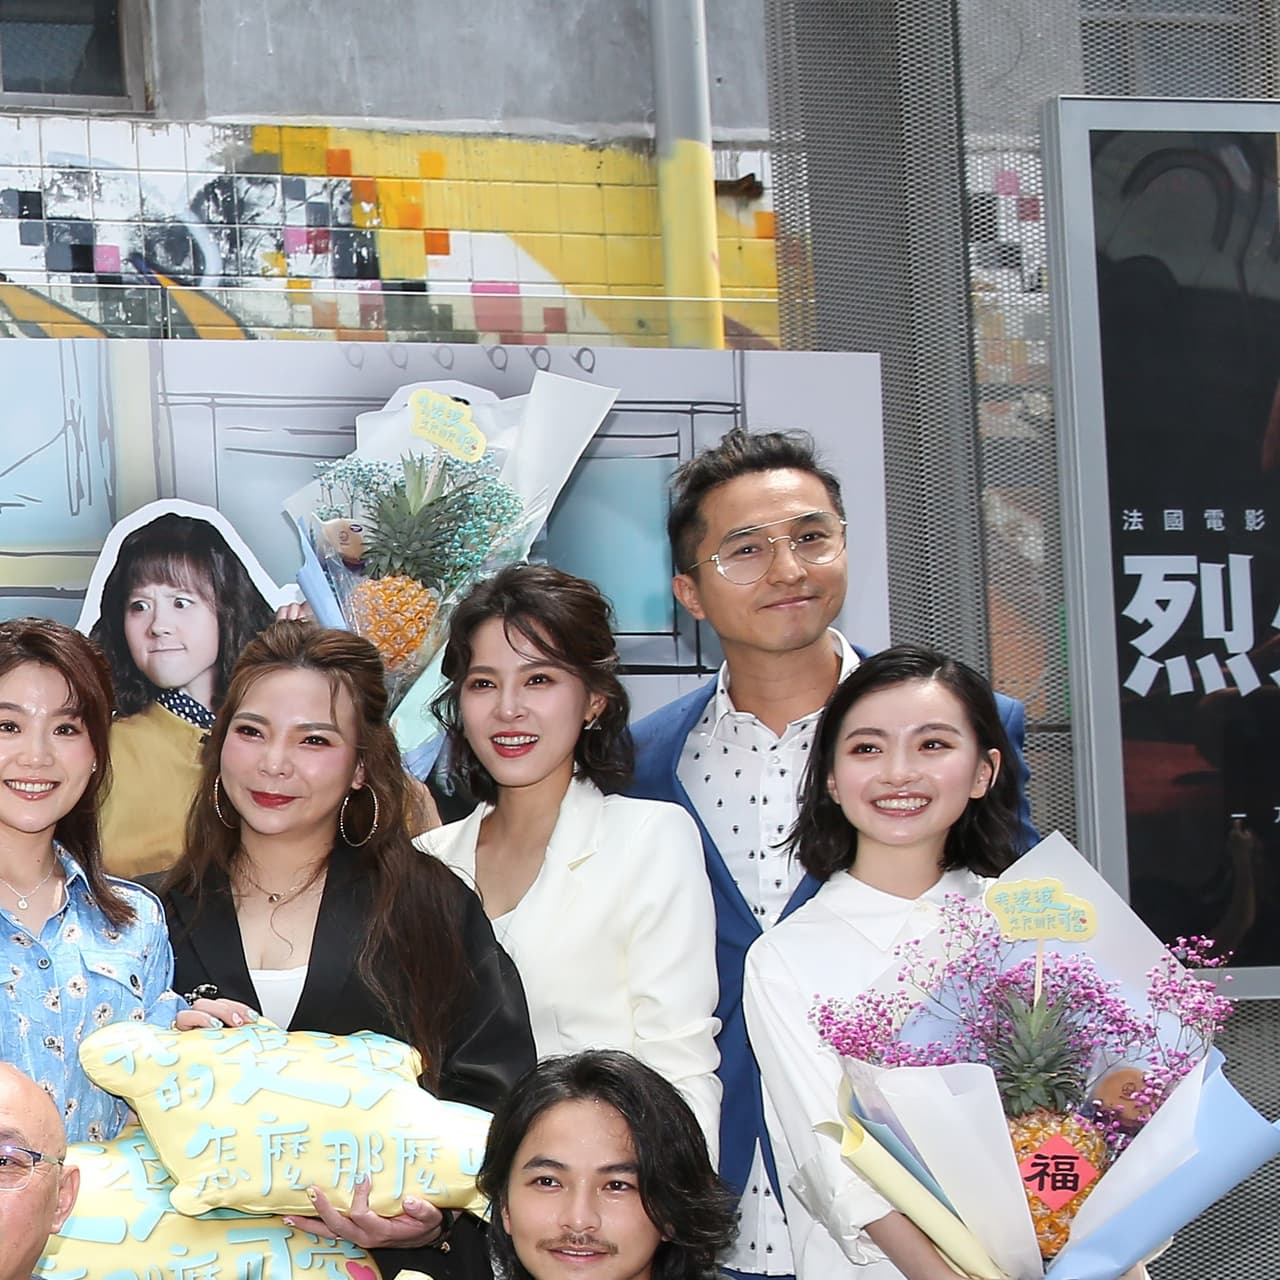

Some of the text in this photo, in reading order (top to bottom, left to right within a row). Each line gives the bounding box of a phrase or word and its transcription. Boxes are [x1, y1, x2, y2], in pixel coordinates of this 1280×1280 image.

[1122, 508, 1266, 532] 法國電影
[1122, 552, 1280, 698] 烈
[1023, 1153, 1080, 1193] 福
